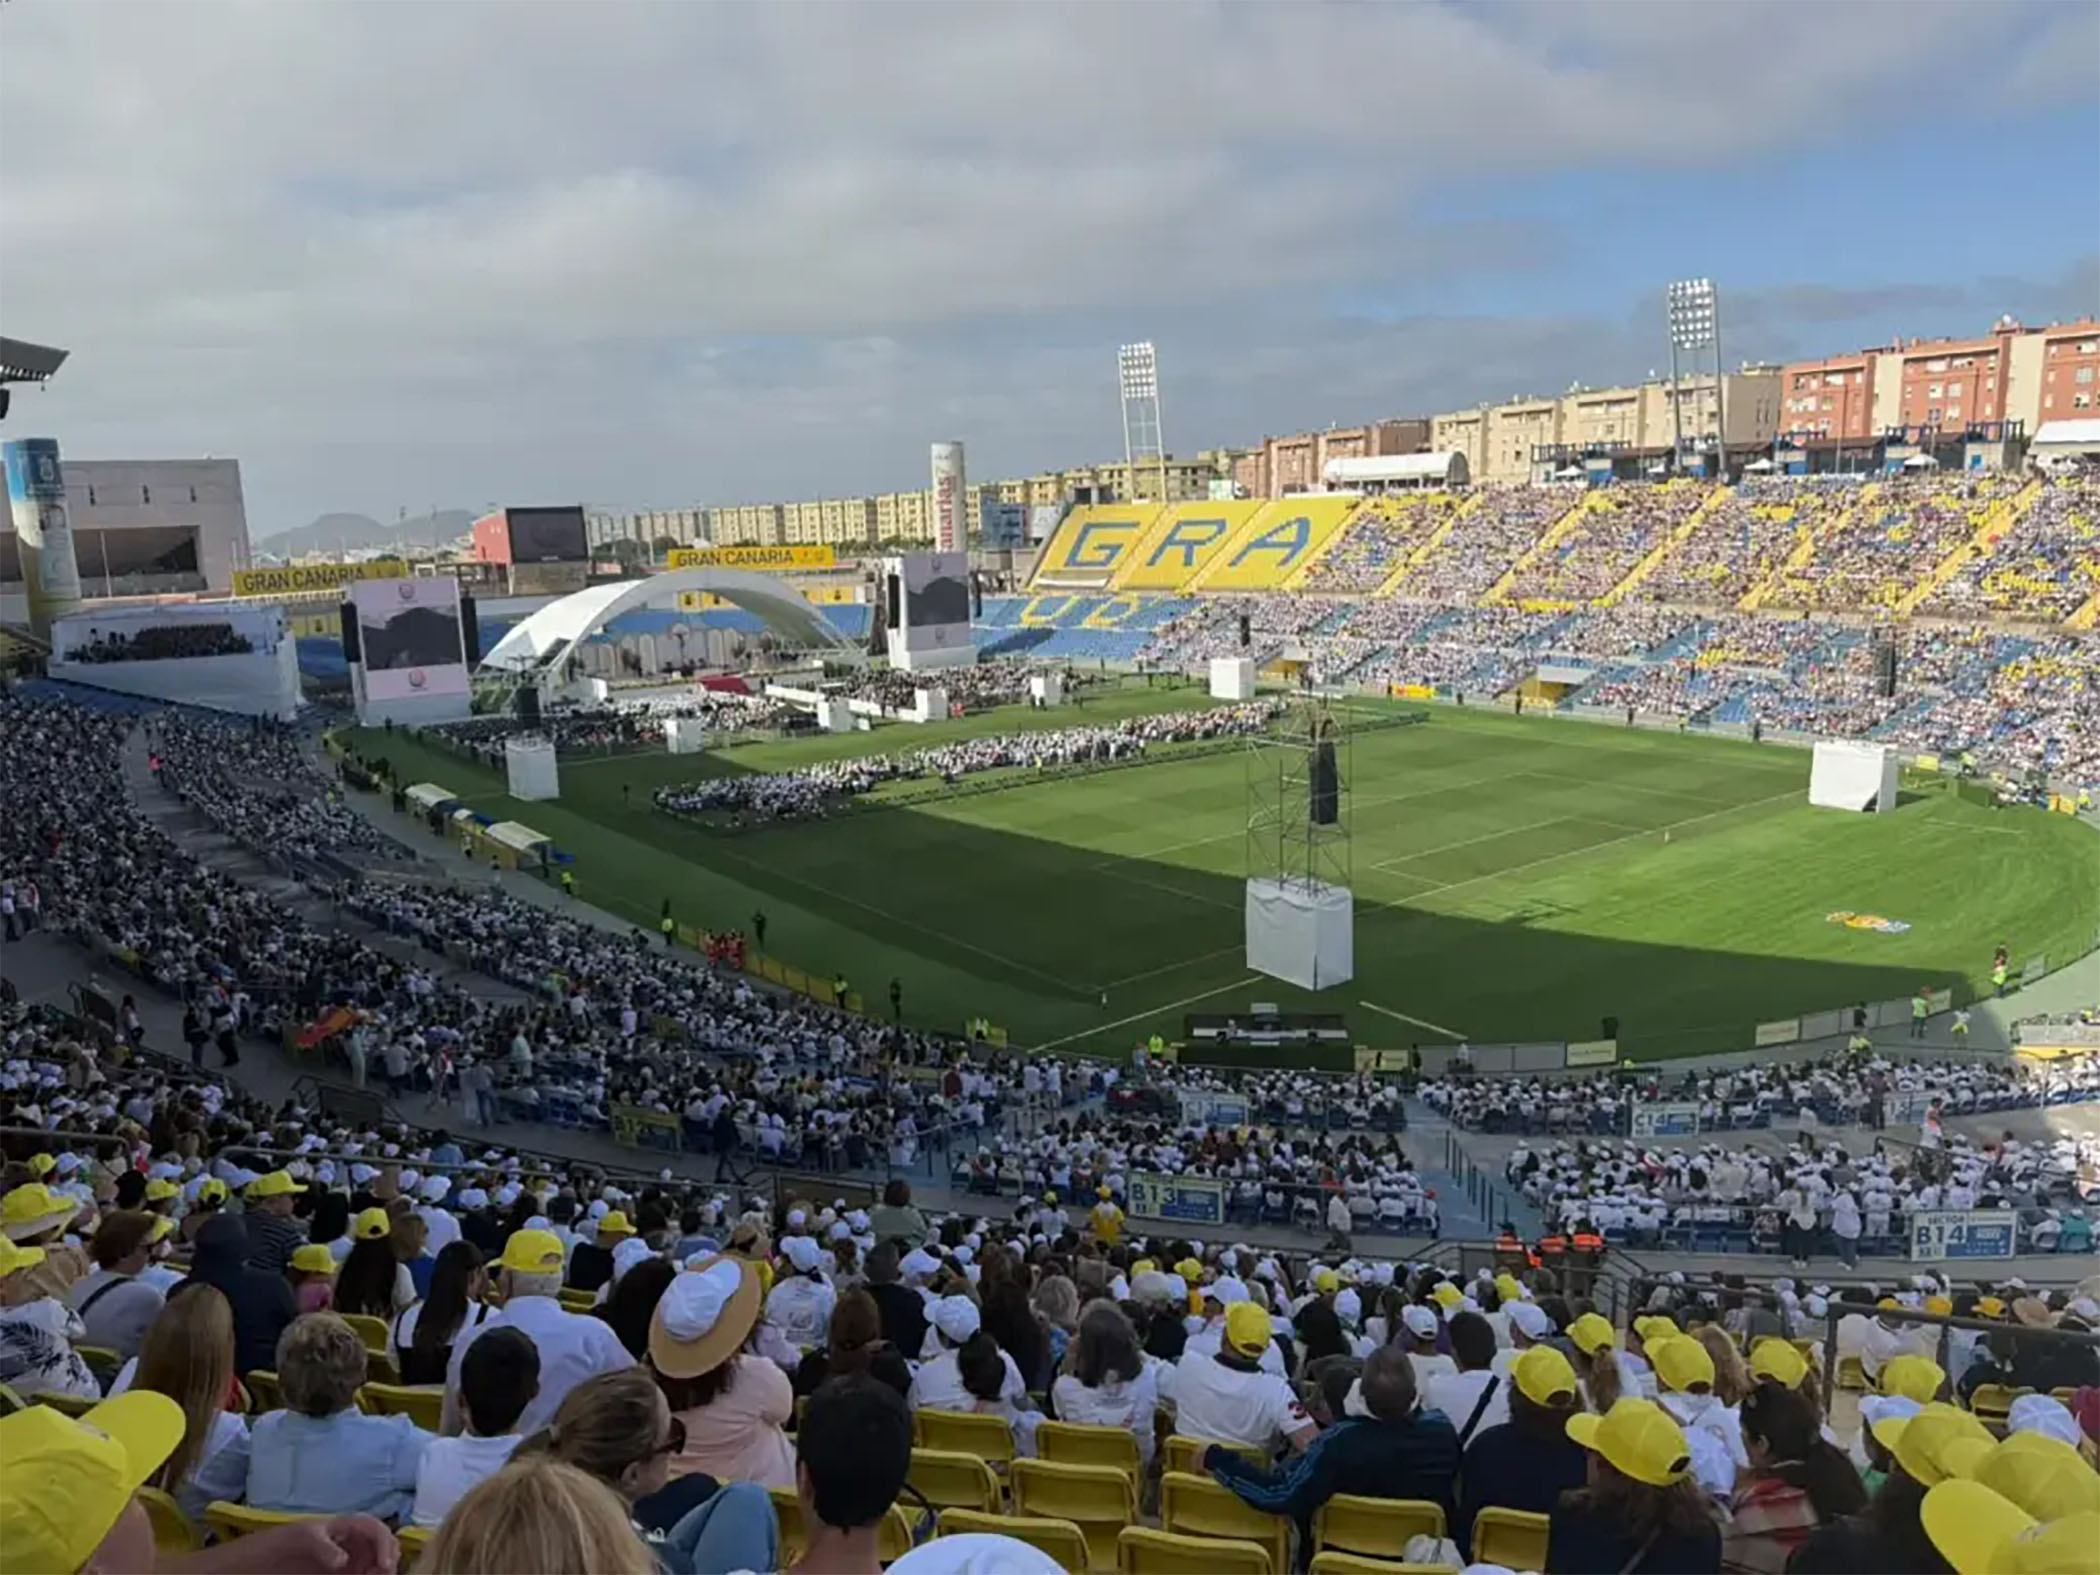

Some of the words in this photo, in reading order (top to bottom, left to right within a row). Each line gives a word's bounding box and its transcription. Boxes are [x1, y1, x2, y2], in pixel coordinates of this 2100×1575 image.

[676, 551, 721, 567] GRAN
[725, 548, 794, 565] CANARIA
[242, 572, 289, 591] GRAN
[293, 566, 364, 586] CANARIA
[1132, 1183, 1176, 1204] B13
[1917, 1226, 1964, 1245] B14
